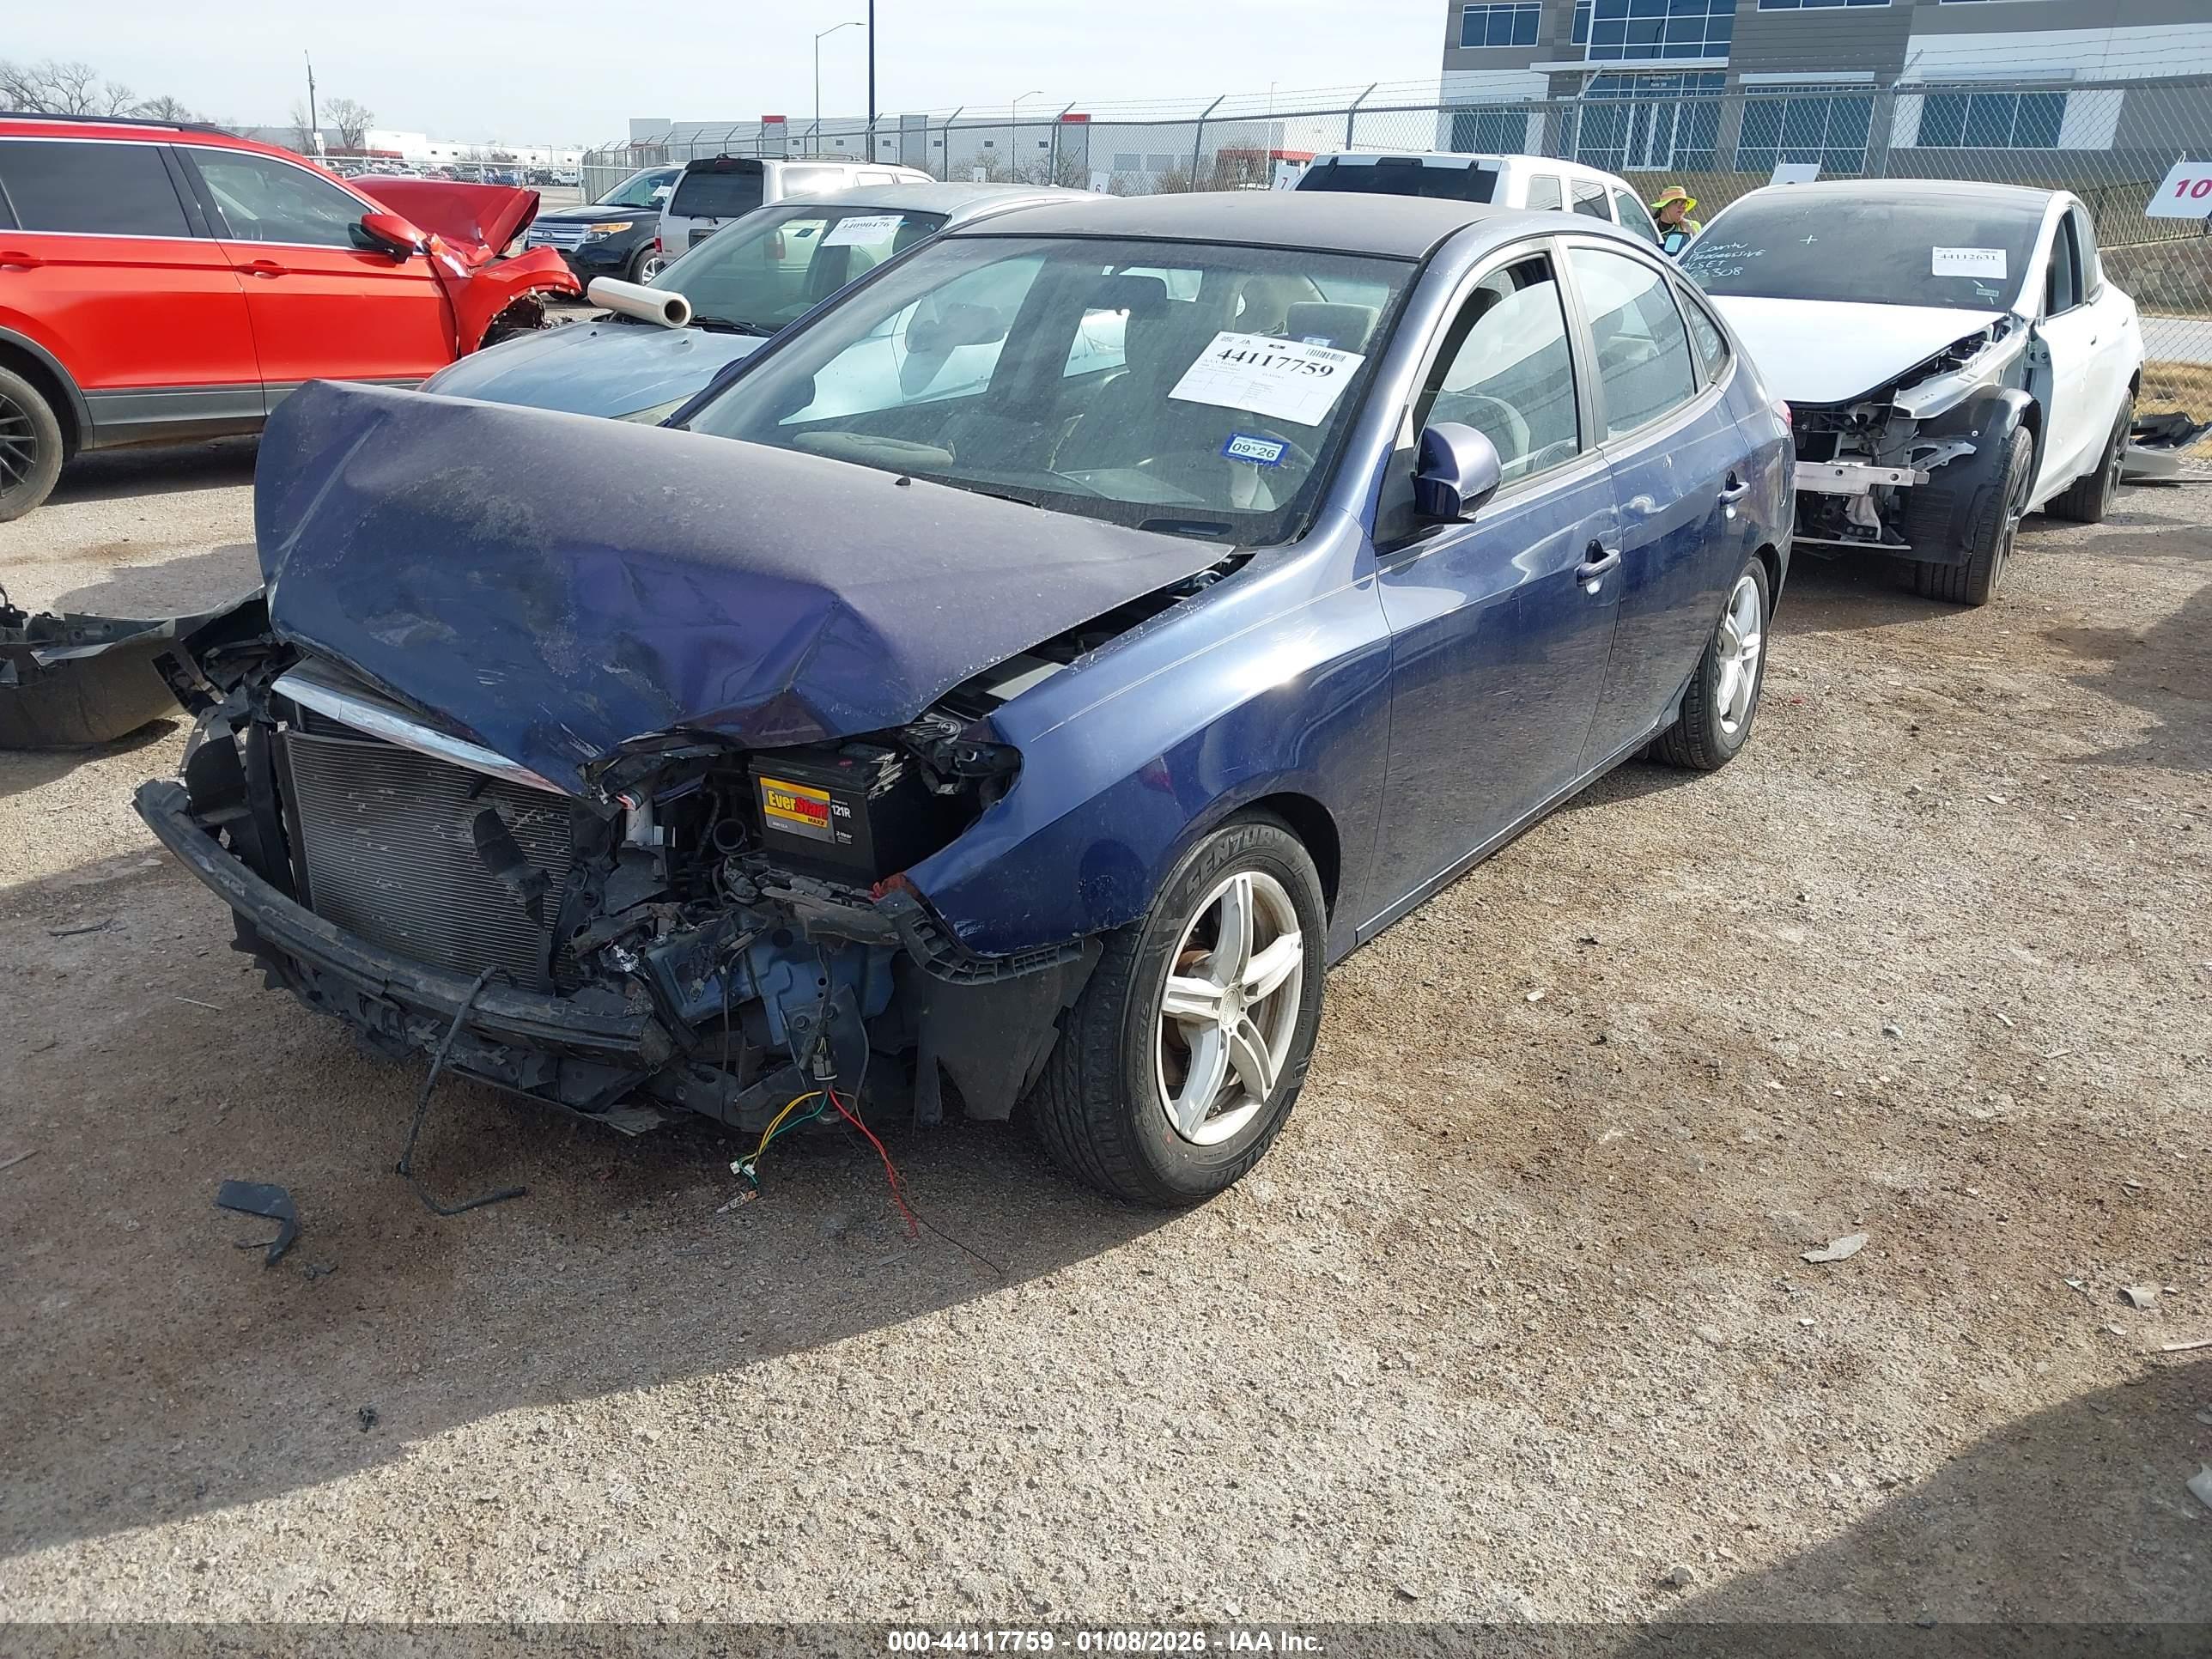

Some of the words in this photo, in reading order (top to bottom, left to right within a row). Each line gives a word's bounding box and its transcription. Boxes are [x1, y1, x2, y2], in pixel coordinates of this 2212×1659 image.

[1281, 177, 1289, 190] 7
[2174, 179, 2212, 198] 10
[1216, 348, 1334, 378] 44117759
[1231, 442, 1251, 453] 09
[1256, 447, 1277, 459] 26
[830, 804, 852, 818] 121R
[807, 817, 825, 826] MAXX
